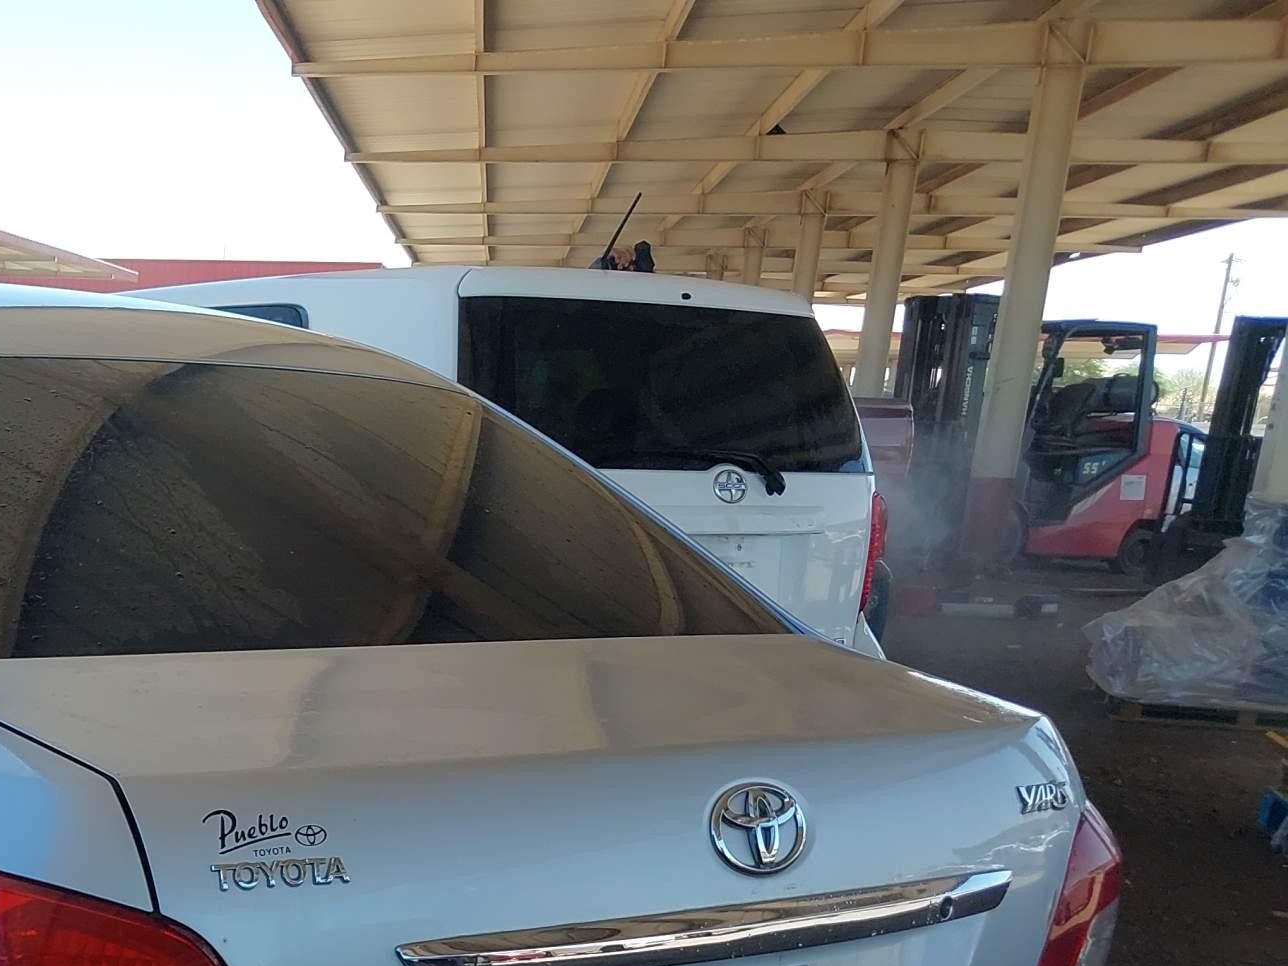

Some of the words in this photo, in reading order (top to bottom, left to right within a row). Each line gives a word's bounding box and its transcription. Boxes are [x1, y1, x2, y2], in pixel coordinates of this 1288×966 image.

[202, 809, 289, 850] Pueblo
[253, 846, 292, 857] TOYOTA
[210, 856, 350, 892] TOYOTA
